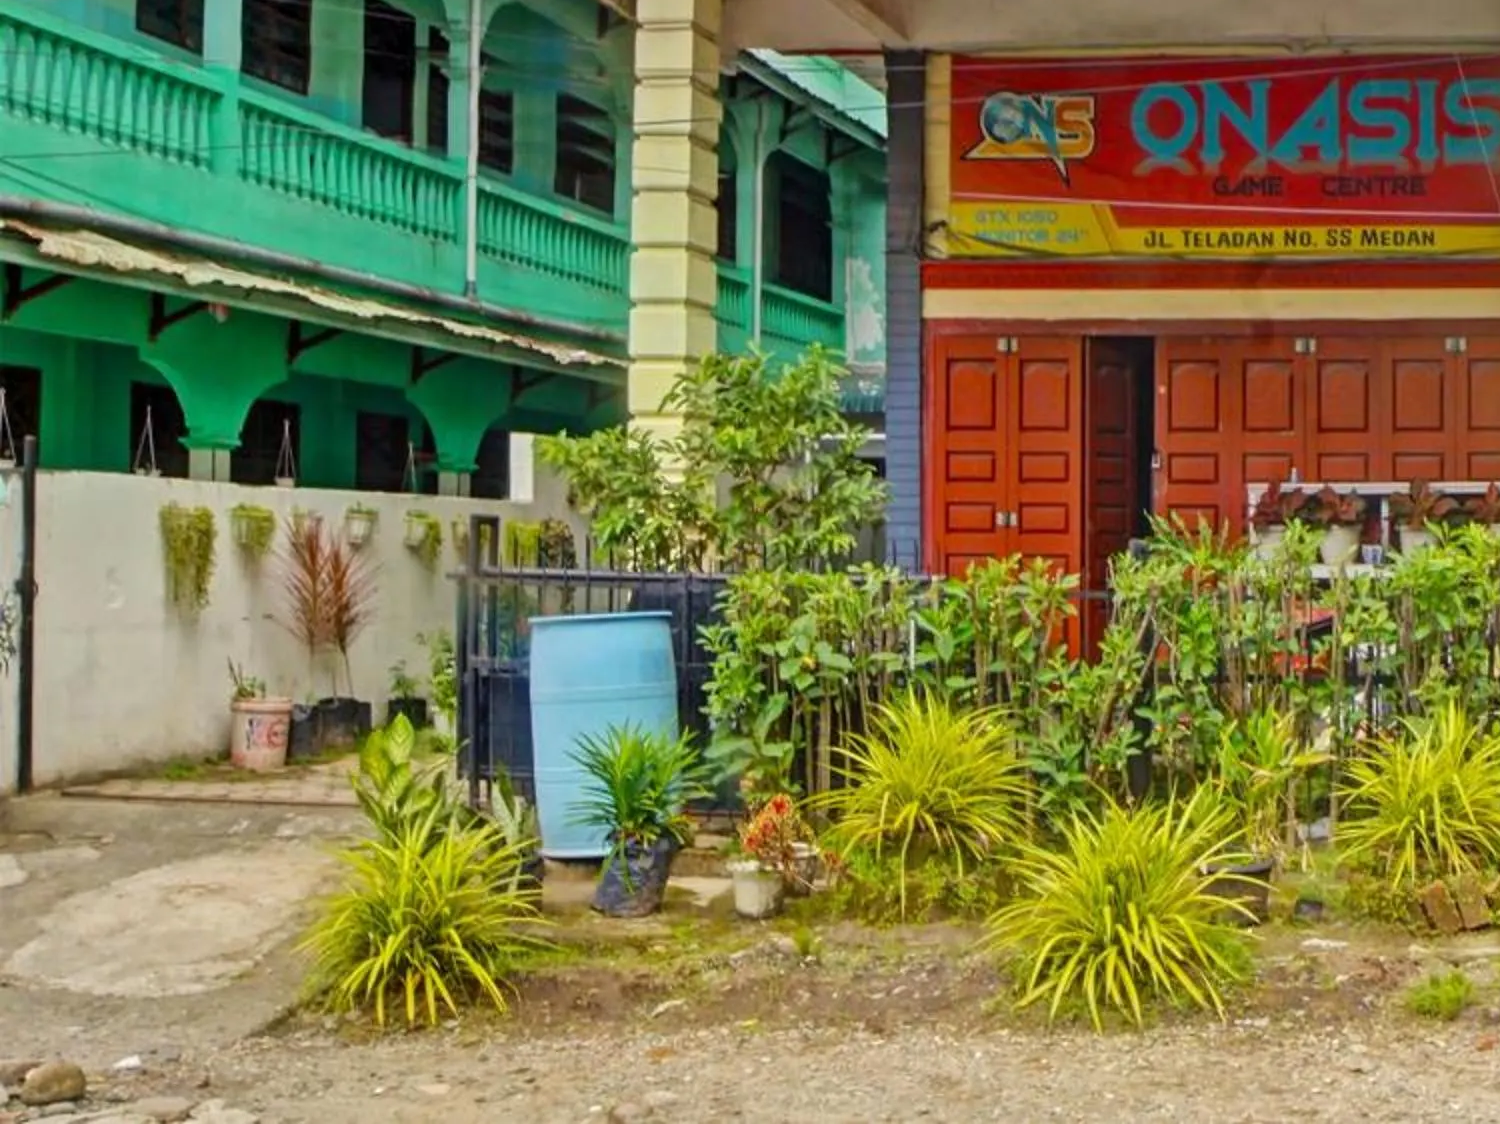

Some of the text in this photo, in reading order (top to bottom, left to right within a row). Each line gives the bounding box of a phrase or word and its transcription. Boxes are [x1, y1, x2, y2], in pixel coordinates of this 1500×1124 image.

[1213, 176, 1428, 197] GAME CENTRE
[1181, 229, 1275, 248] TELADAN
[1360, 228, 1436, 247] MEDAN
